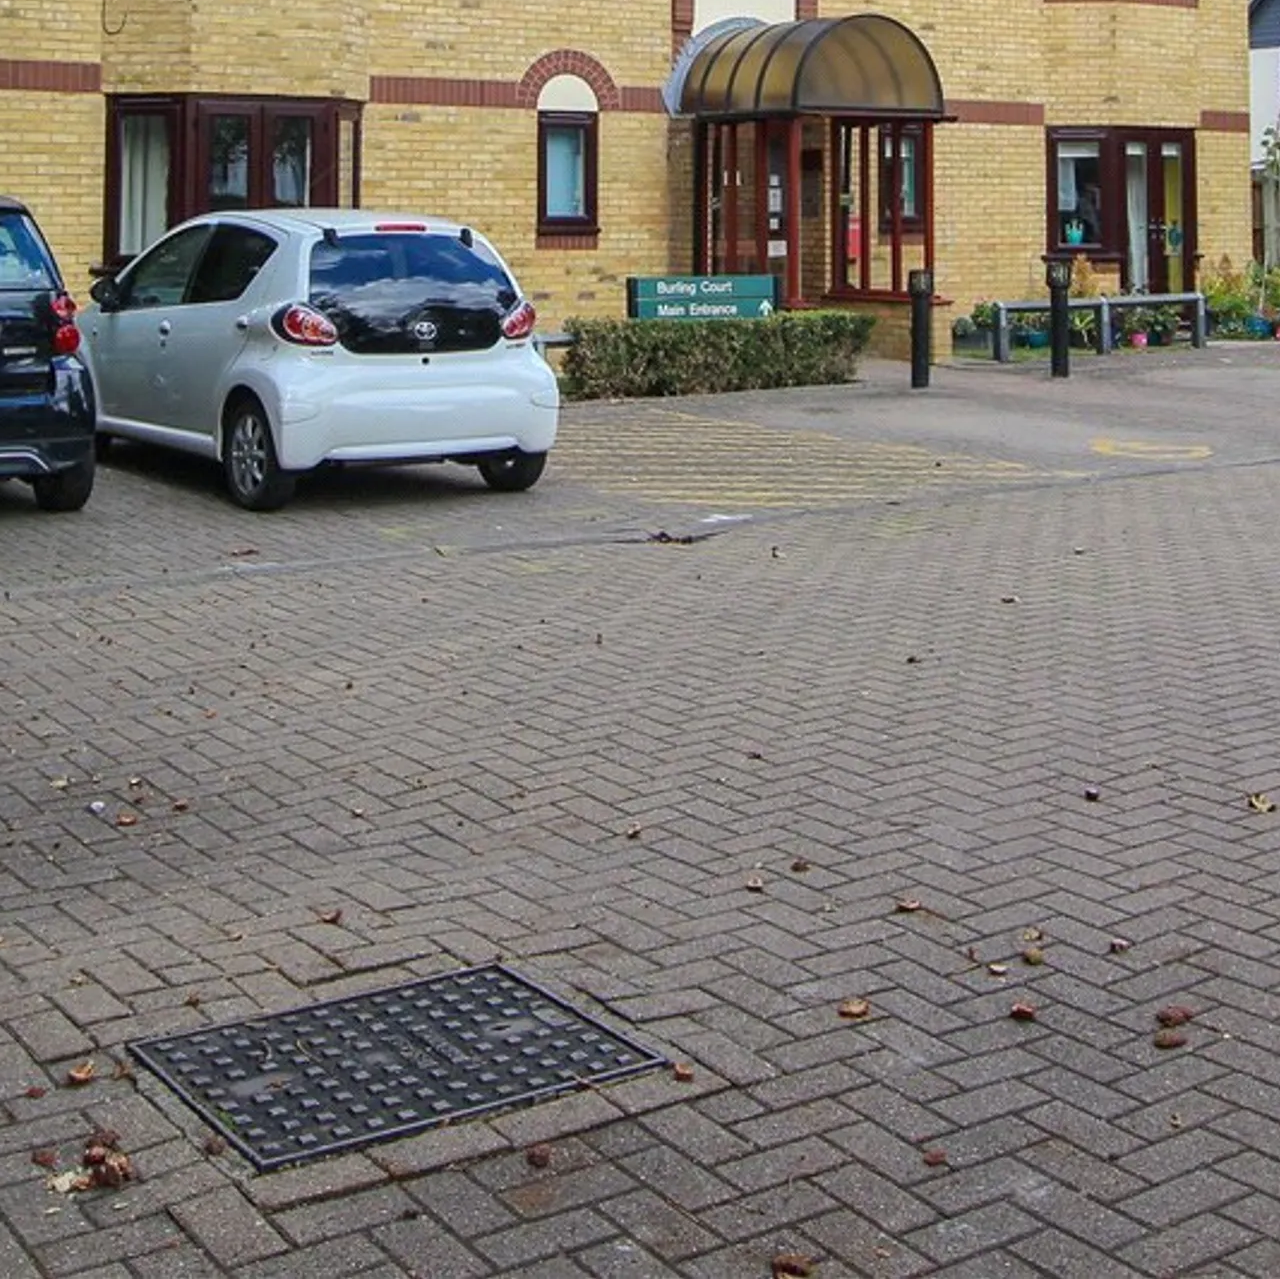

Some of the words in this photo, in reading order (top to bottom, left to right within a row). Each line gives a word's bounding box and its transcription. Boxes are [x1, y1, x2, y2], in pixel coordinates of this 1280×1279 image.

[656, 281, 697, 296] Burling
[700, 280, 733, 293] Court
[656, 304, 686, 316] Main
[689, 303, 738, 316] Entrance
